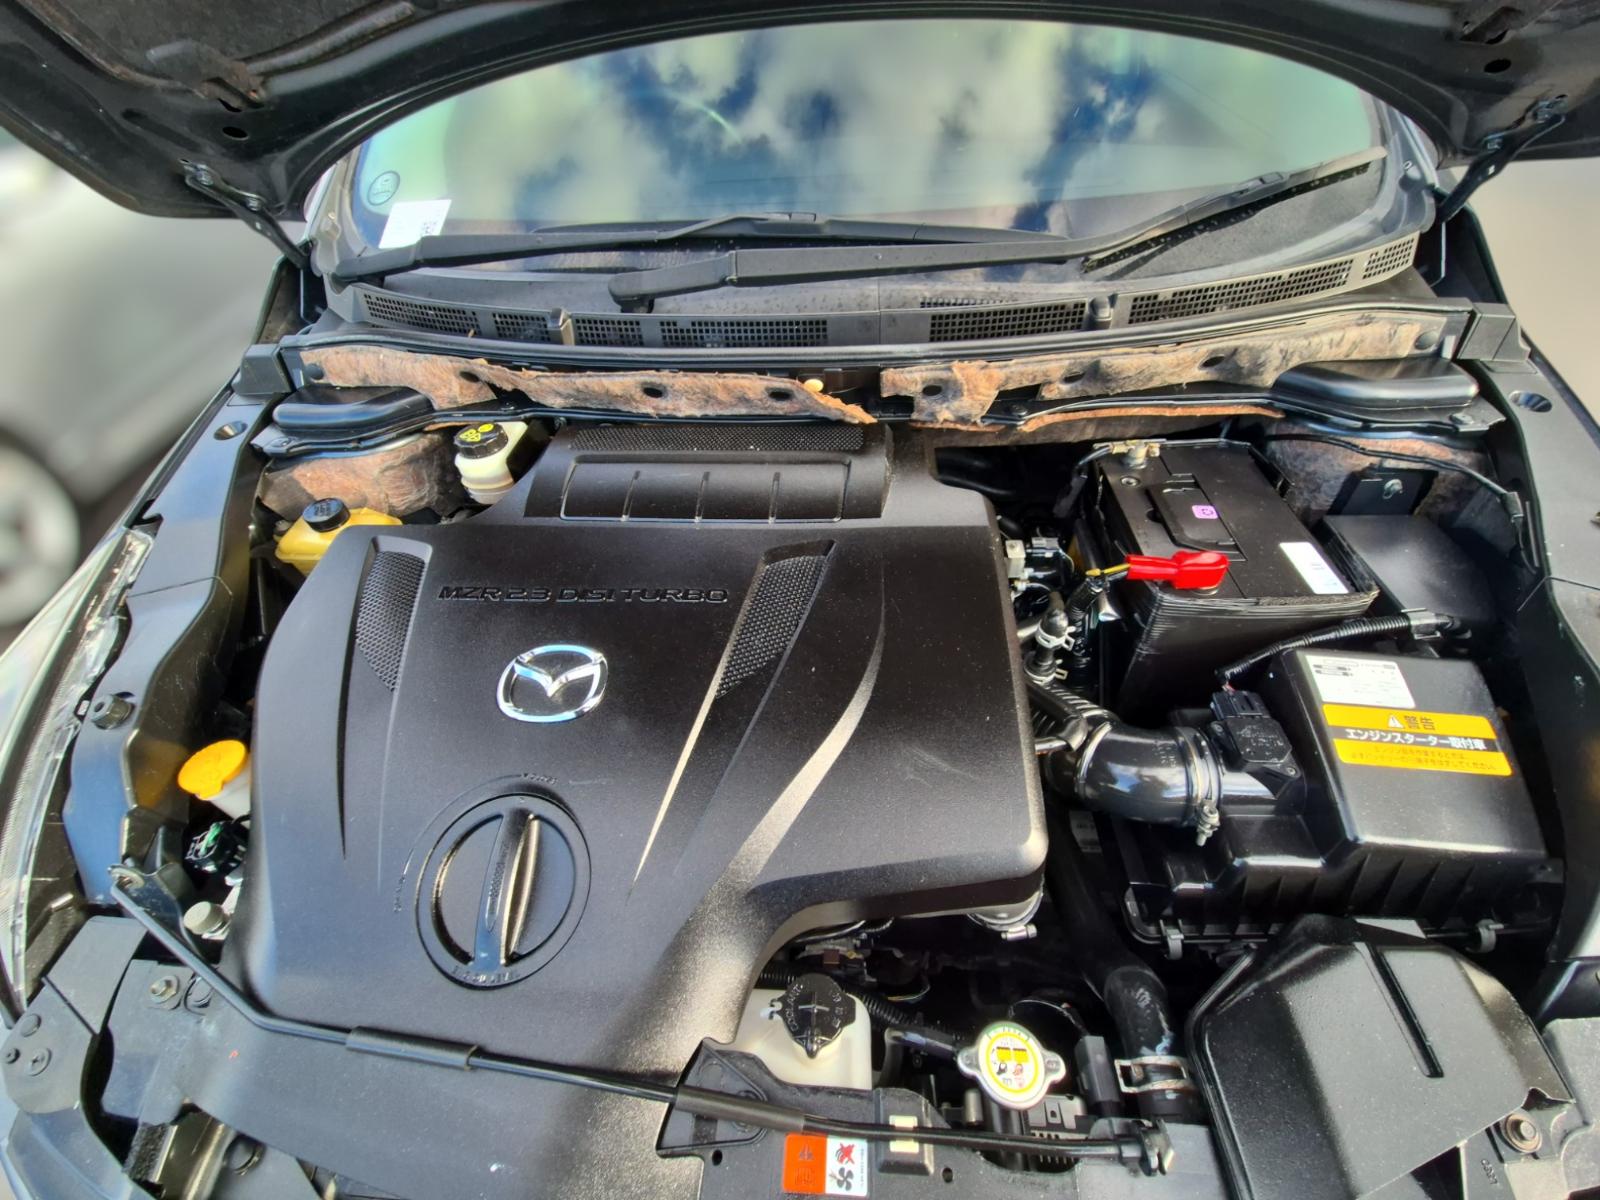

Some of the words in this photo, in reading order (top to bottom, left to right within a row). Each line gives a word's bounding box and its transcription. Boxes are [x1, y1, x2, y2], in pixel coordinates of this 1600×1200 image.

[438, 586, 501, 602] MZR
[556, 587, 615, 603] DISI
[621, 588, 729, 604] TURBO
[1403, 714, 1436, 731] 警告
